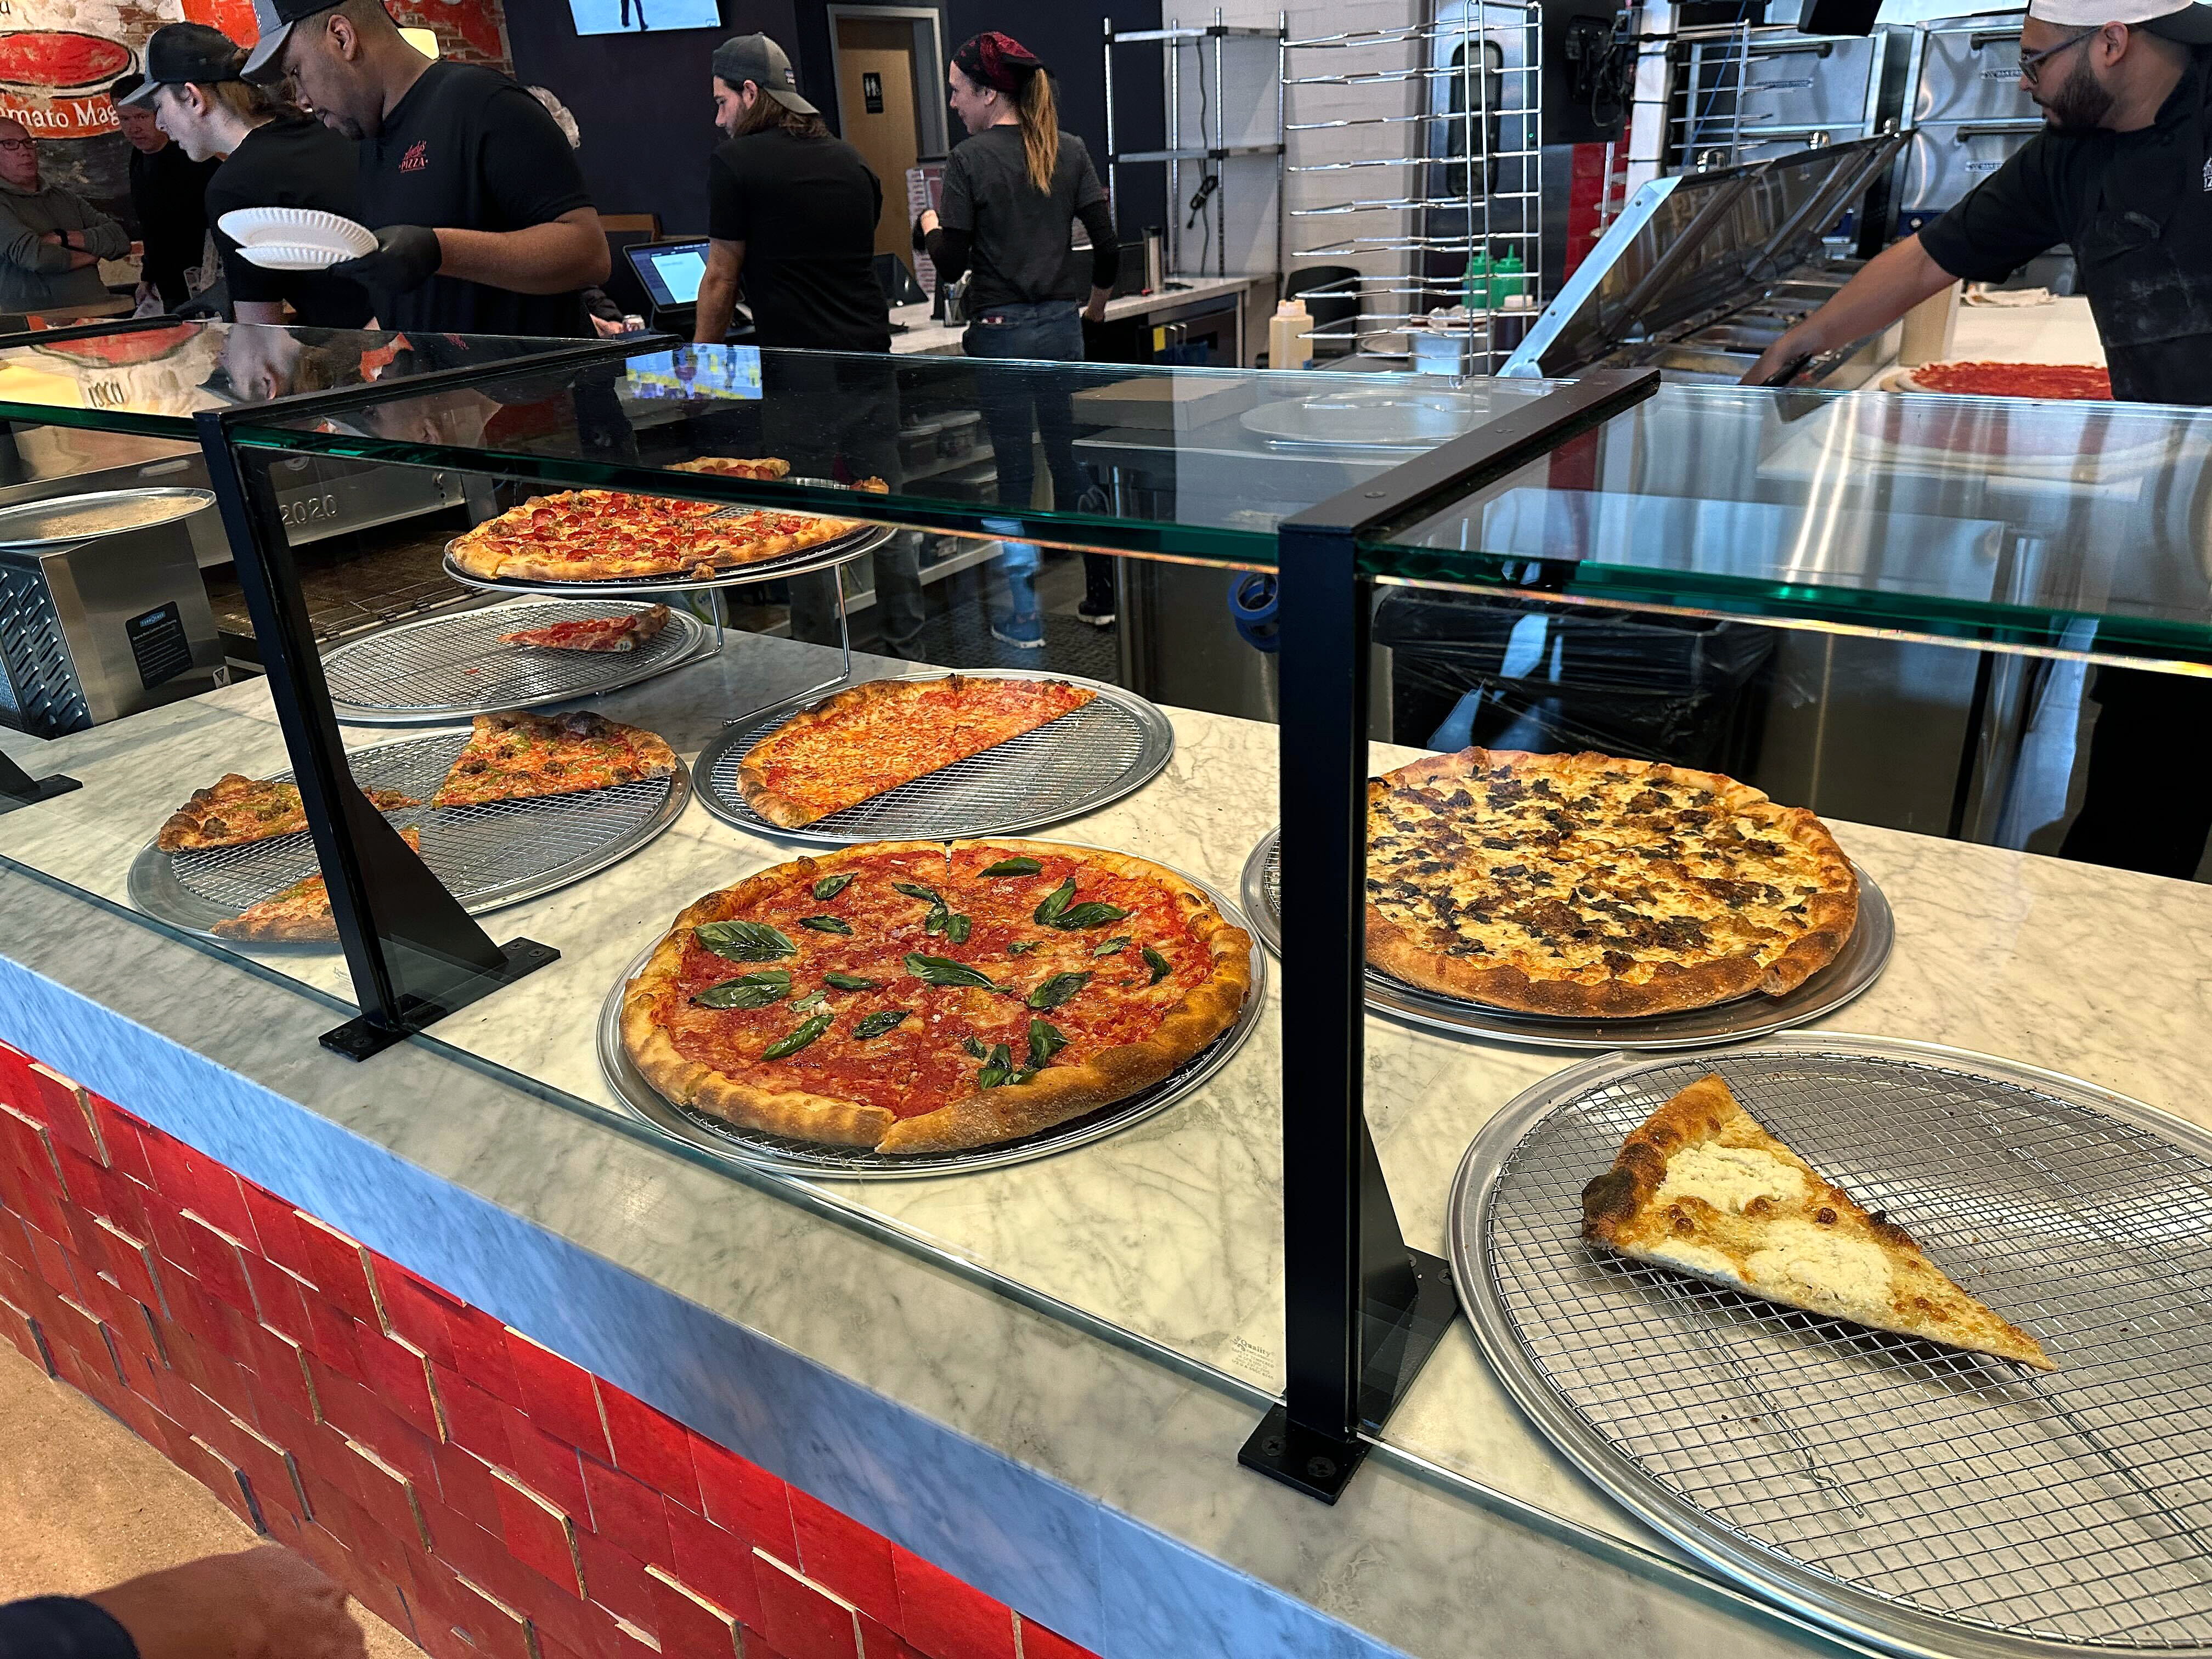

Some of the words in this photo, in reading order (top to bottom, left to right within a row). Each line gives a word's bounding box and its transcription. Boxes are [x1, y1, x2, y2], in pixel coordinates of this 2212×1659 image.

[400, 157, 425, 171] PIZZA
[280, 494, 338, 527] 2020
[1240, 1339, 1271, 1357] Quality
